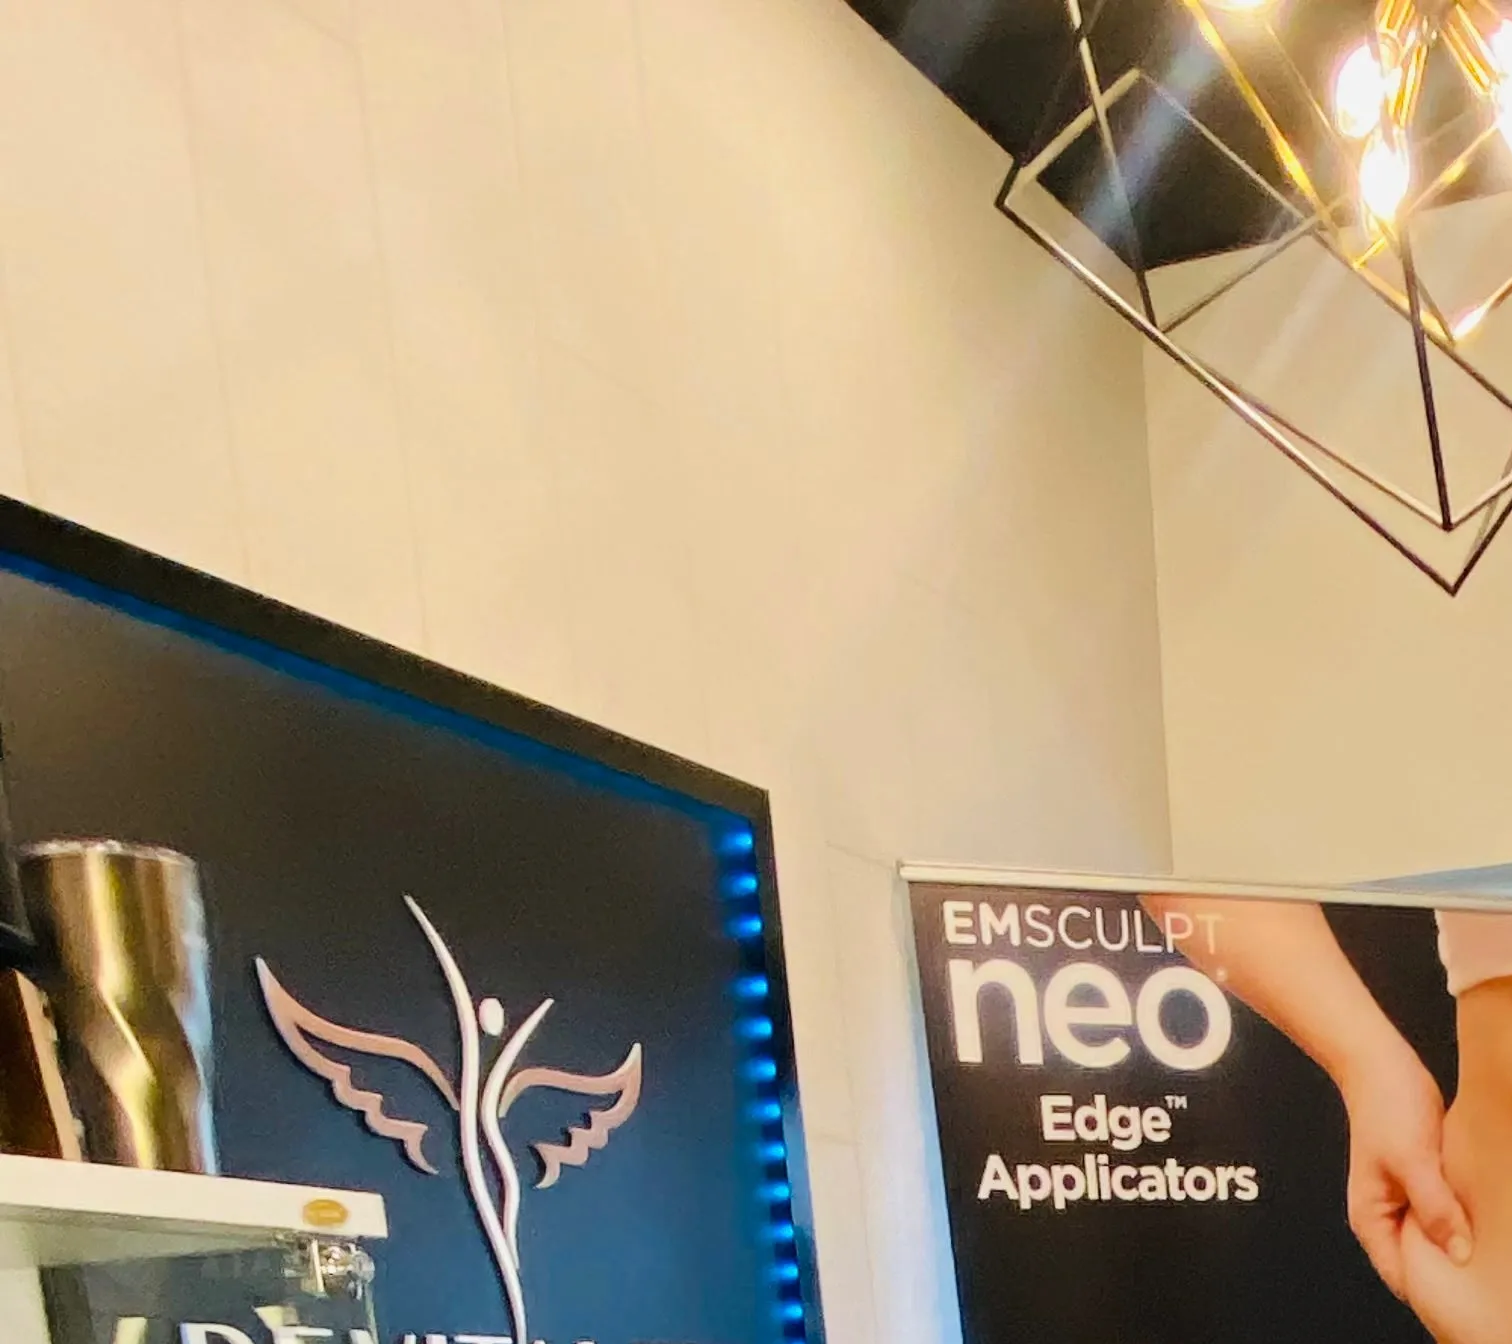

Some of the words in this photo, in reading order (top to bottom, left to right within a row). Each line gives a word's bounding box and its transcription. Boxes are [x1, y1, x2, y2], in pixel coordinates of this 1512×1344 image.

[943, 900, 1224, 955] EMSCULPT
[948, 958, 1232, 1070] neo
[977, 1154, 1260, 1210] Applicators
